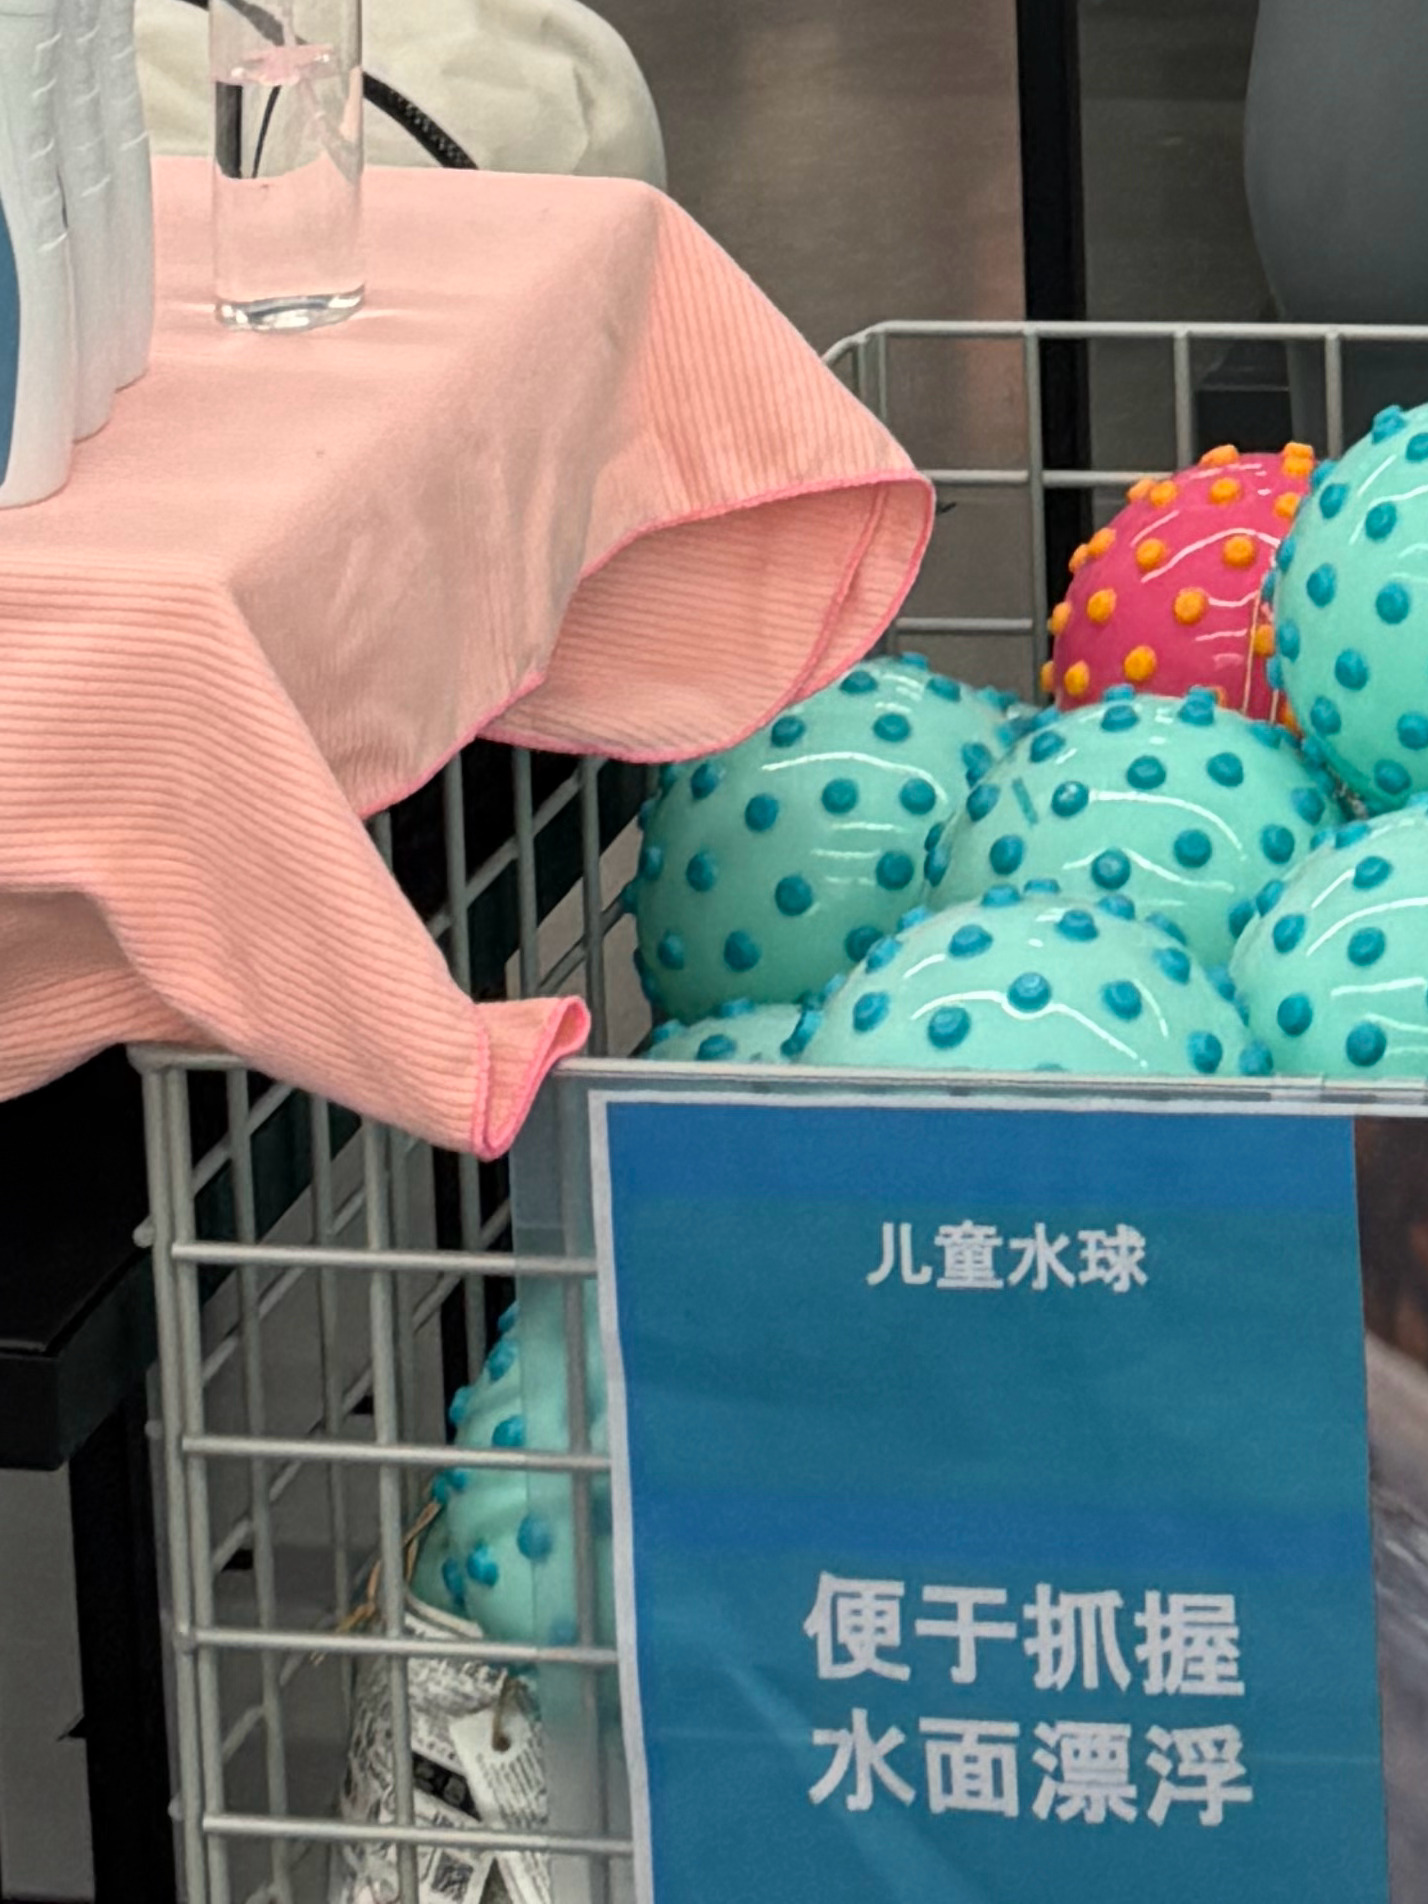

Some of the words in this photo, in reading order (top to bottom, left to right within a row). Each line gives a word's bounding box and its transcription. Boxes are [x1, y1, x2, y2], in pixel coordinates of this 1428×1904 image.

[867, 1219, 1149, 1291] 儿童水球
[804, 1571, 1246, 1697] 便于抓握
[808, 1707, 1254, 1827] 水面漂浮
